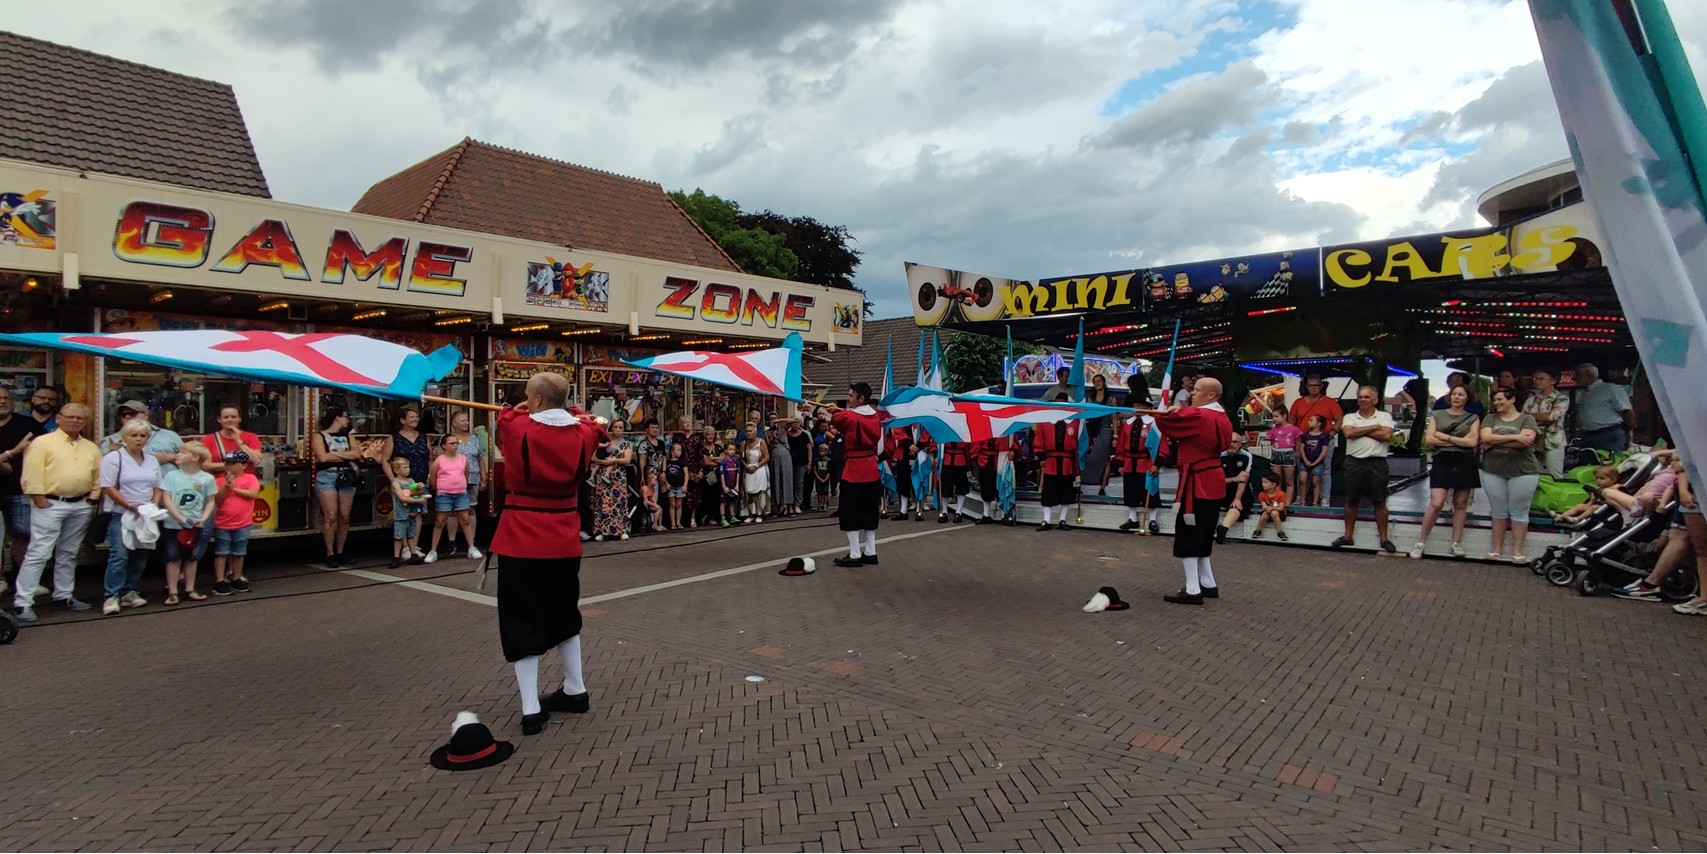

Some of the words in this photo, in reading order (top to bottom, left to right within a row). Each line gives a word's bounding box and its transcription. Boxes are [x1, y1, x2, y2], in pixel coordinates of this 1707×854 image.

[112, 200, 473, 297] GAME
[655, 275, 817, 332] ZONE
[1324, 224, 1579, 288] CARS
[179, 493, 196, 506] P
